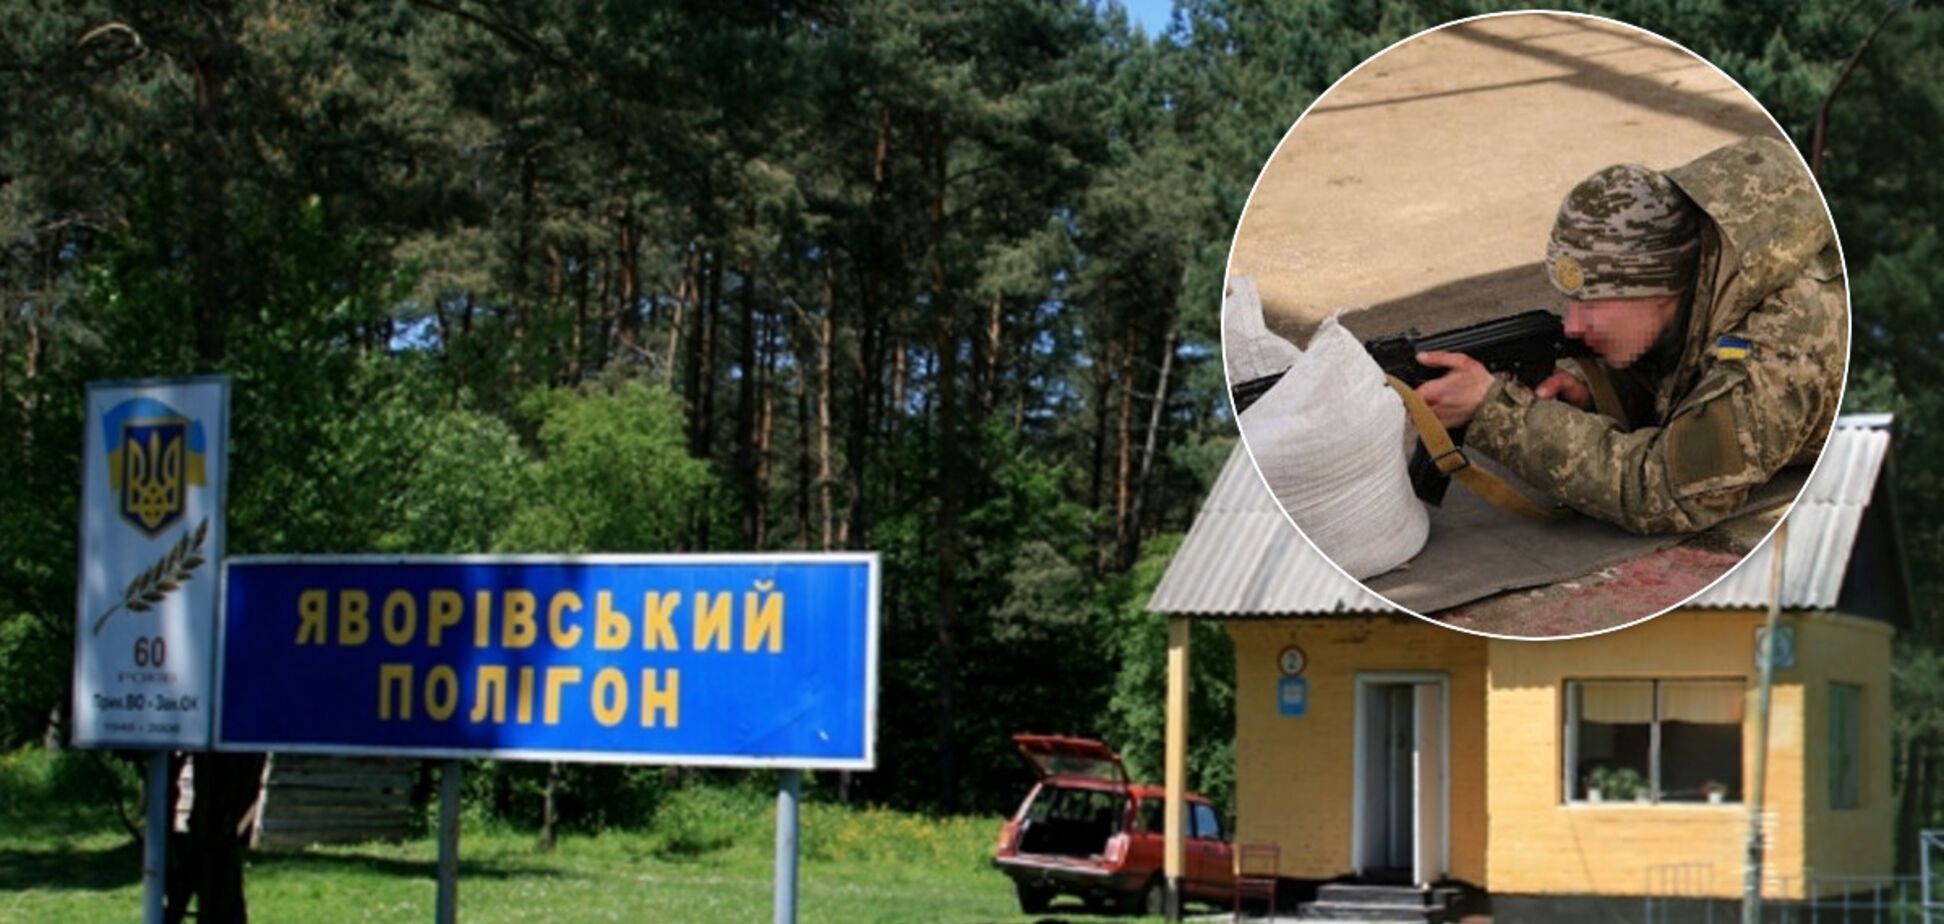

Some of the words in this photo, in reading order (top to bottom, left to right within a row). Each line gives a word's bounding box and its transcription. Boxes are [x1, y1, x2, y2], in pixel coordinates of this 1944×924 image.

[295, 579, 784, 653] ЯВОРІВСЬКИЙ
[134, 636, 167, 668] 60
[377, 664, 681, 728] ПОЛІГОН
